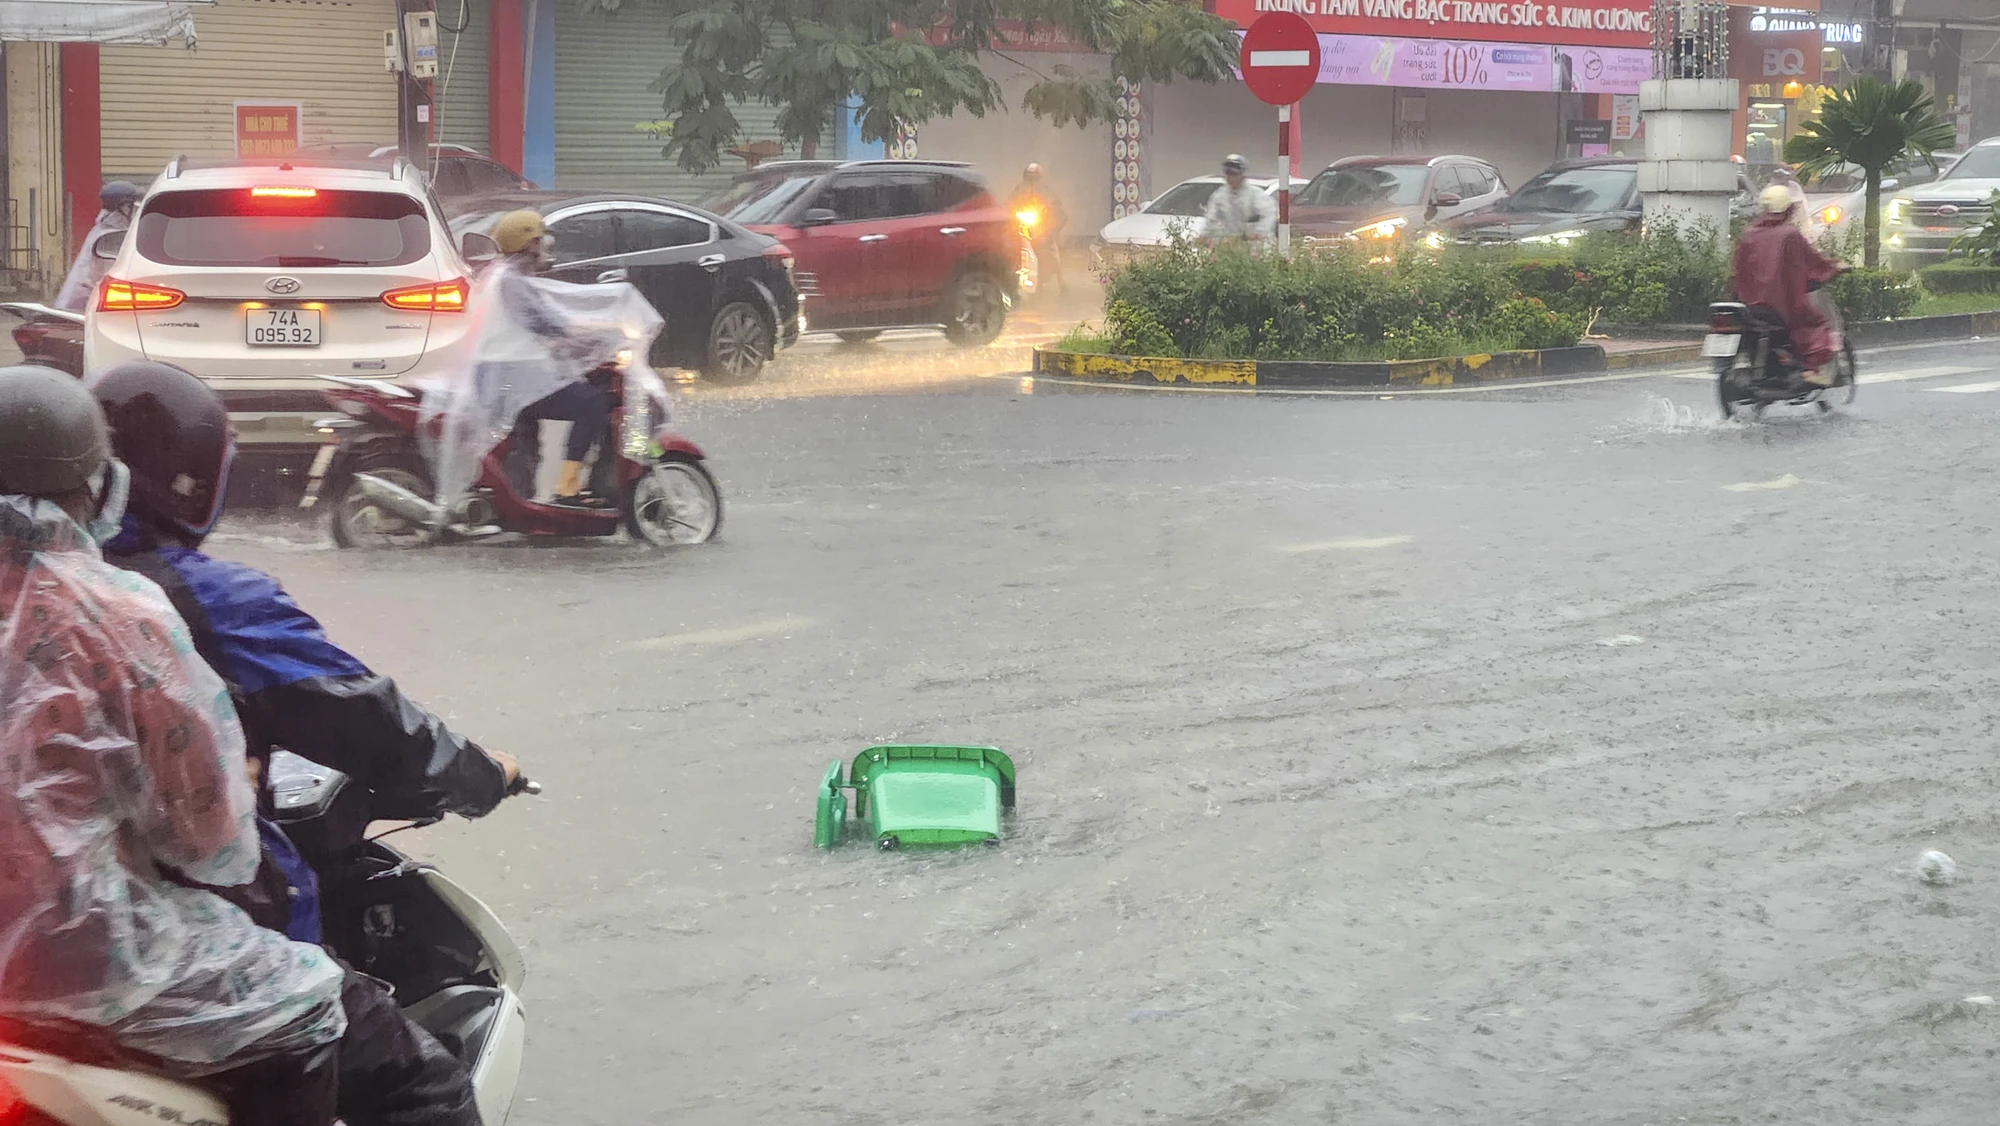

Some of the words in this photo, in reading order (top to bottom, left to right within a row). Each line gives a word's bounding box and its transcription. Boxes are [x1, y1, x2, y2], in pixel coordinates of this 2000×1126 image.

[1415, 0, 1451, 25] BẠC
[1452, 1, 1508, 25] TRANG
[1510, 0, 1543, 26] SỨC
[1546, 5, 1561, 27] &
[1561, 7, 1593, 29] KIM
[1594, 8, 1650, 33] CƯƠNG
[1442, 46, 1488, 85] 10%
[1763, 48, 1806, 76] BQ
[268, 310, 299, 326] 74A
[255, 327, 313, 343] 095.92
